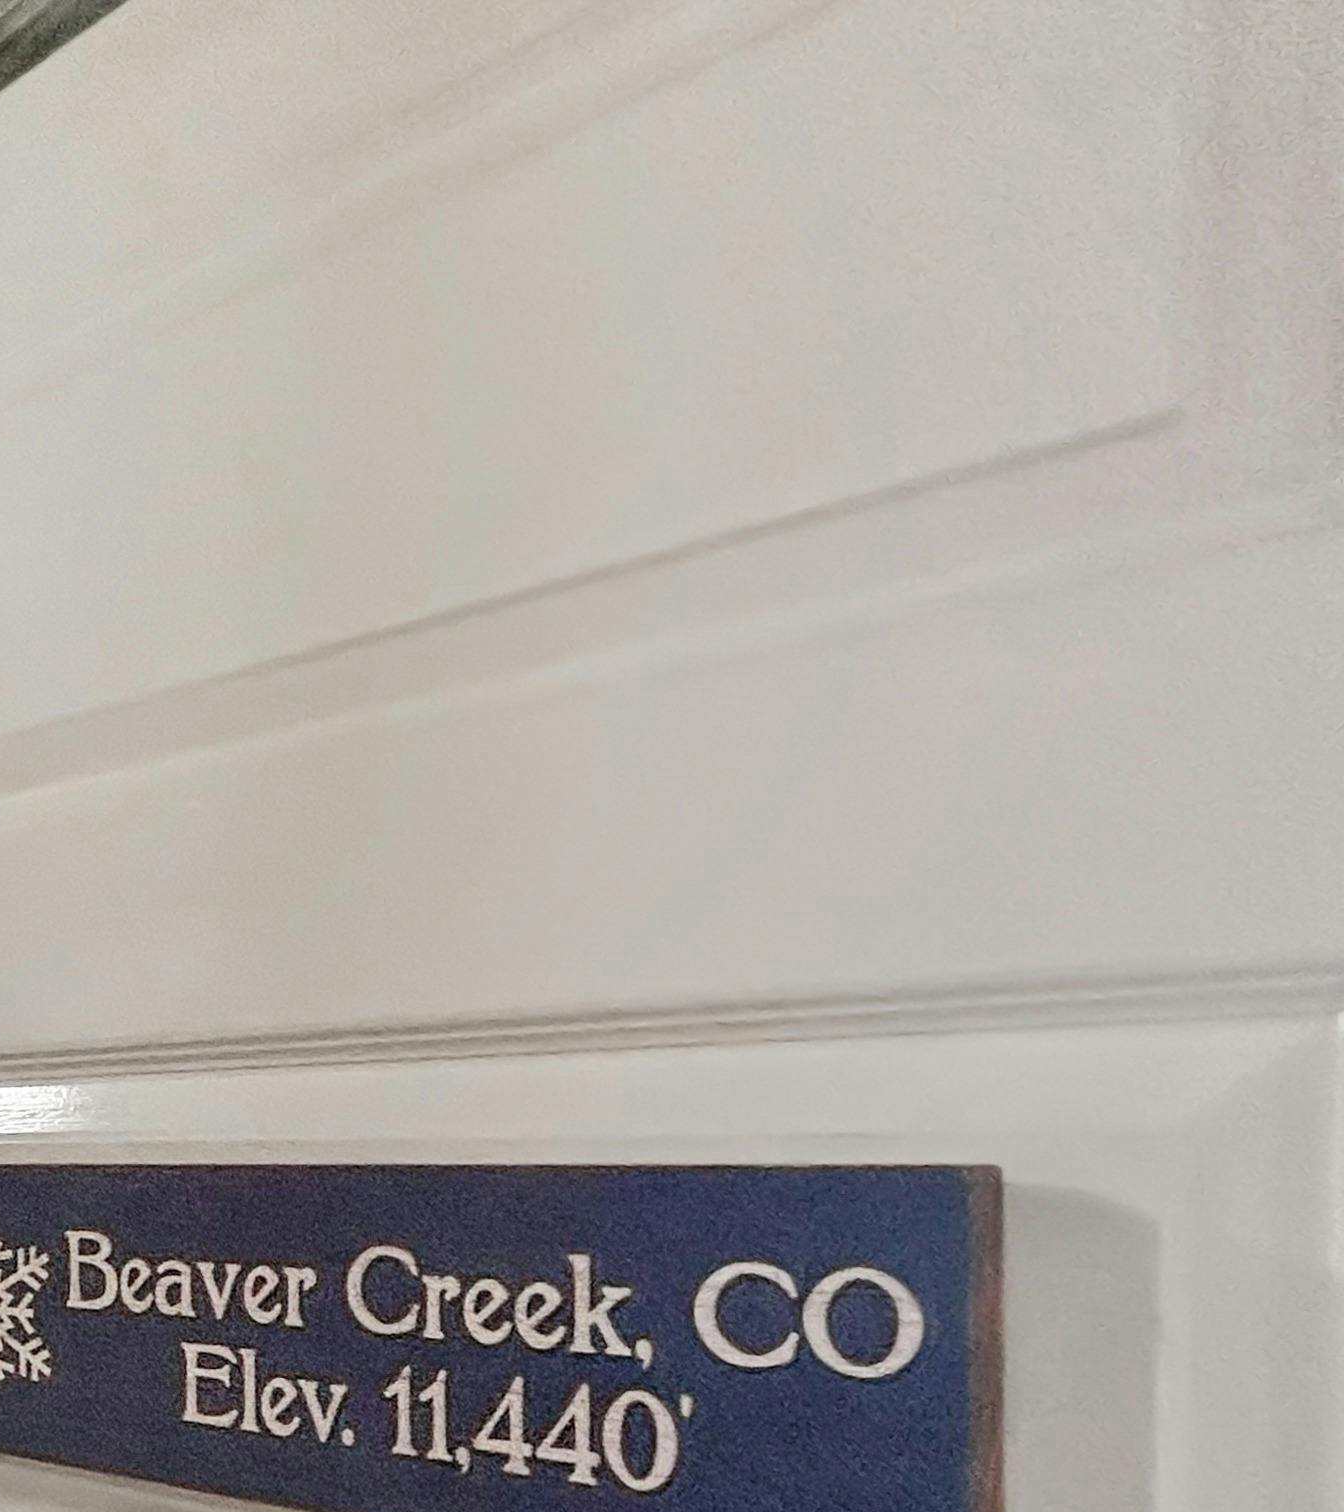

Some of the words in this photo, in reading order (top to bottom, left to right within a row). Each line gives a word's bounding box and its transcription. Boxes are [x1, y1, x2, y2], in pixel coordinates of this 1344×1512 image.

[63, 1229, 318, 1334] Beaver
[345, 1244, 654, 1369] Creek,
[692, 1260, 925, 1379] CO
[179, 1341, 355, 1447] Elev.
[382, 1364, 694, 1492] 11,440'
